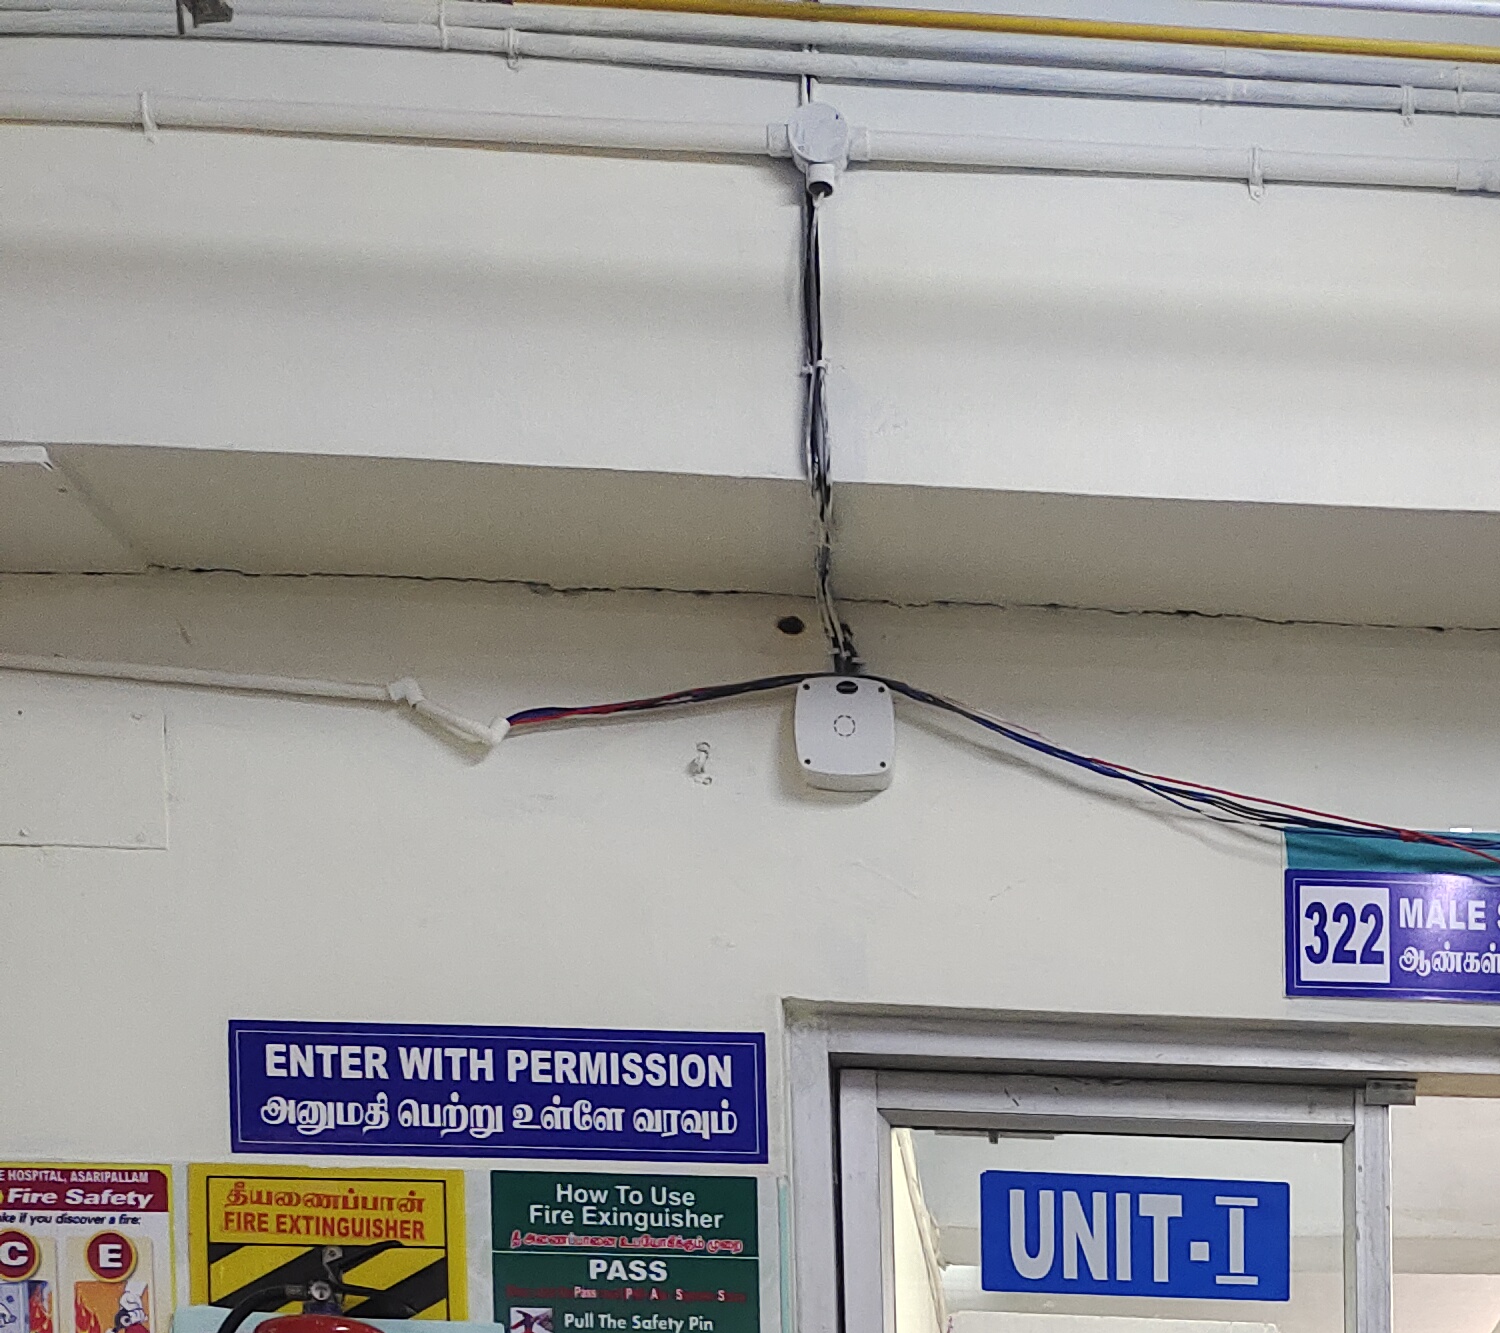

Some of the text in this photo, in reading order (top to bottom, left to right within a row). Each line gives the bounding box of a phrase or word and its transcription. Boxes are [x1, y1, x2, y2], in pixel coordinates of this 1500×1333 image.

[1400, 898, 1486, 932] MALE
[1304, 903, 1384, 964] 322
[265, 1044, 732, 1088] ENTER WITH PERMISSION
[261, 1092, 737, 1140] அனுமதி பெற்று உள்ளே வரவும்
[8, 1170, 66, 1182] HOSPITAL,
[70, 1172, 148, 1182] ASARIPALLAM
[8, 1188, 154, 1208] Fire Safety
[556, 1184, 695, 1205] How To Use
[19, 1213, 28, 1223] if
[30, 1215, 52, 1225] you
[56, 1214, 106, 1224] discover
[108, 1216, 115, 1224] a
[224, 1212, 425, 1239] FIRE EXTINGUISHER
[530, 1205, 724, 1231] Fire Exinguisher
[1, 1241, 29, 1266] C
[99, 1244, 123, 1268] E
[589, 1260, 668, 1281] PASS
[564, 1314, 713, 1333] Pull The Safety Pin
